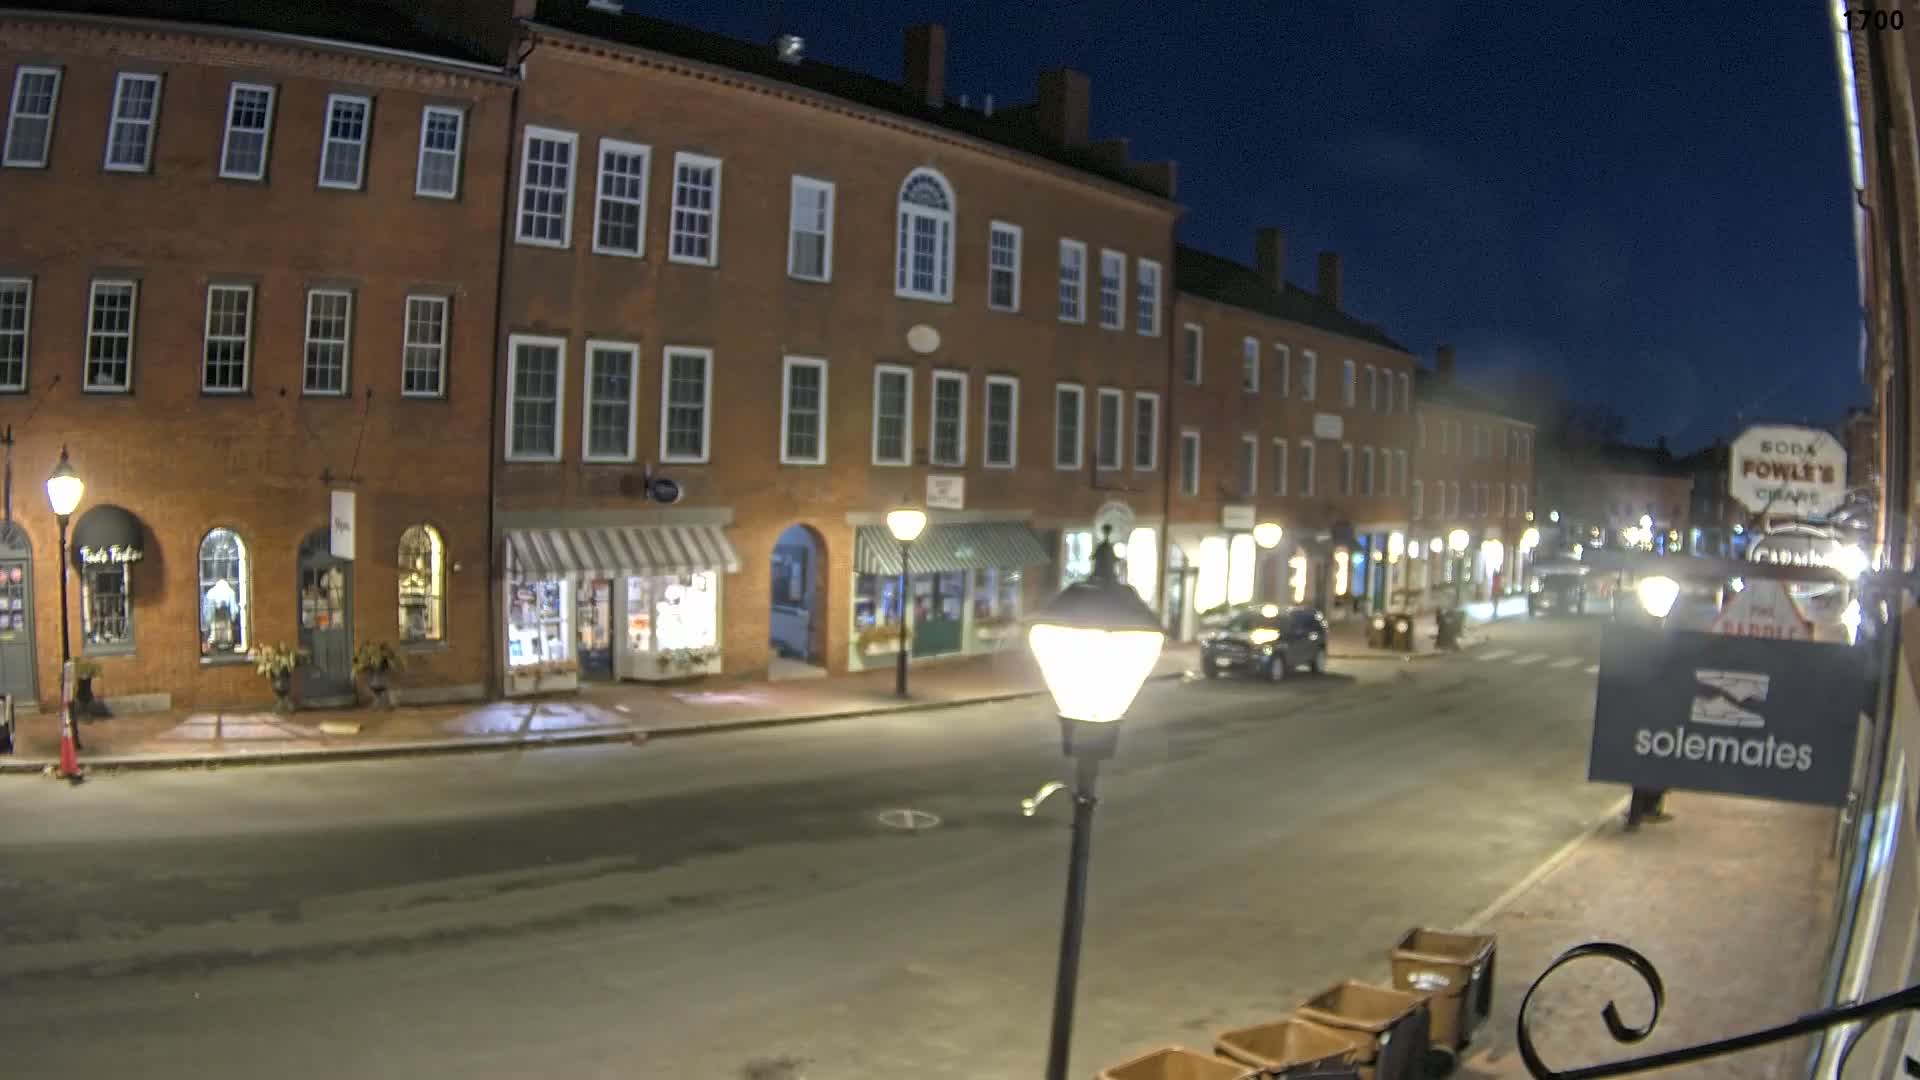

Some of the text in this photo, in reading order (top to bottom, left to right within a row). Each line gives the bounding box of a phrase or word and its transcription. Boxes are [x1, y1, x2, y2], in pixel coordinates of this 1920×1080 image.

[1760, 440, 1817, 458] SODA
[1743, 459, 1835, 484] FOWLE'S
[1635, 726, 1813, 771] solemates
